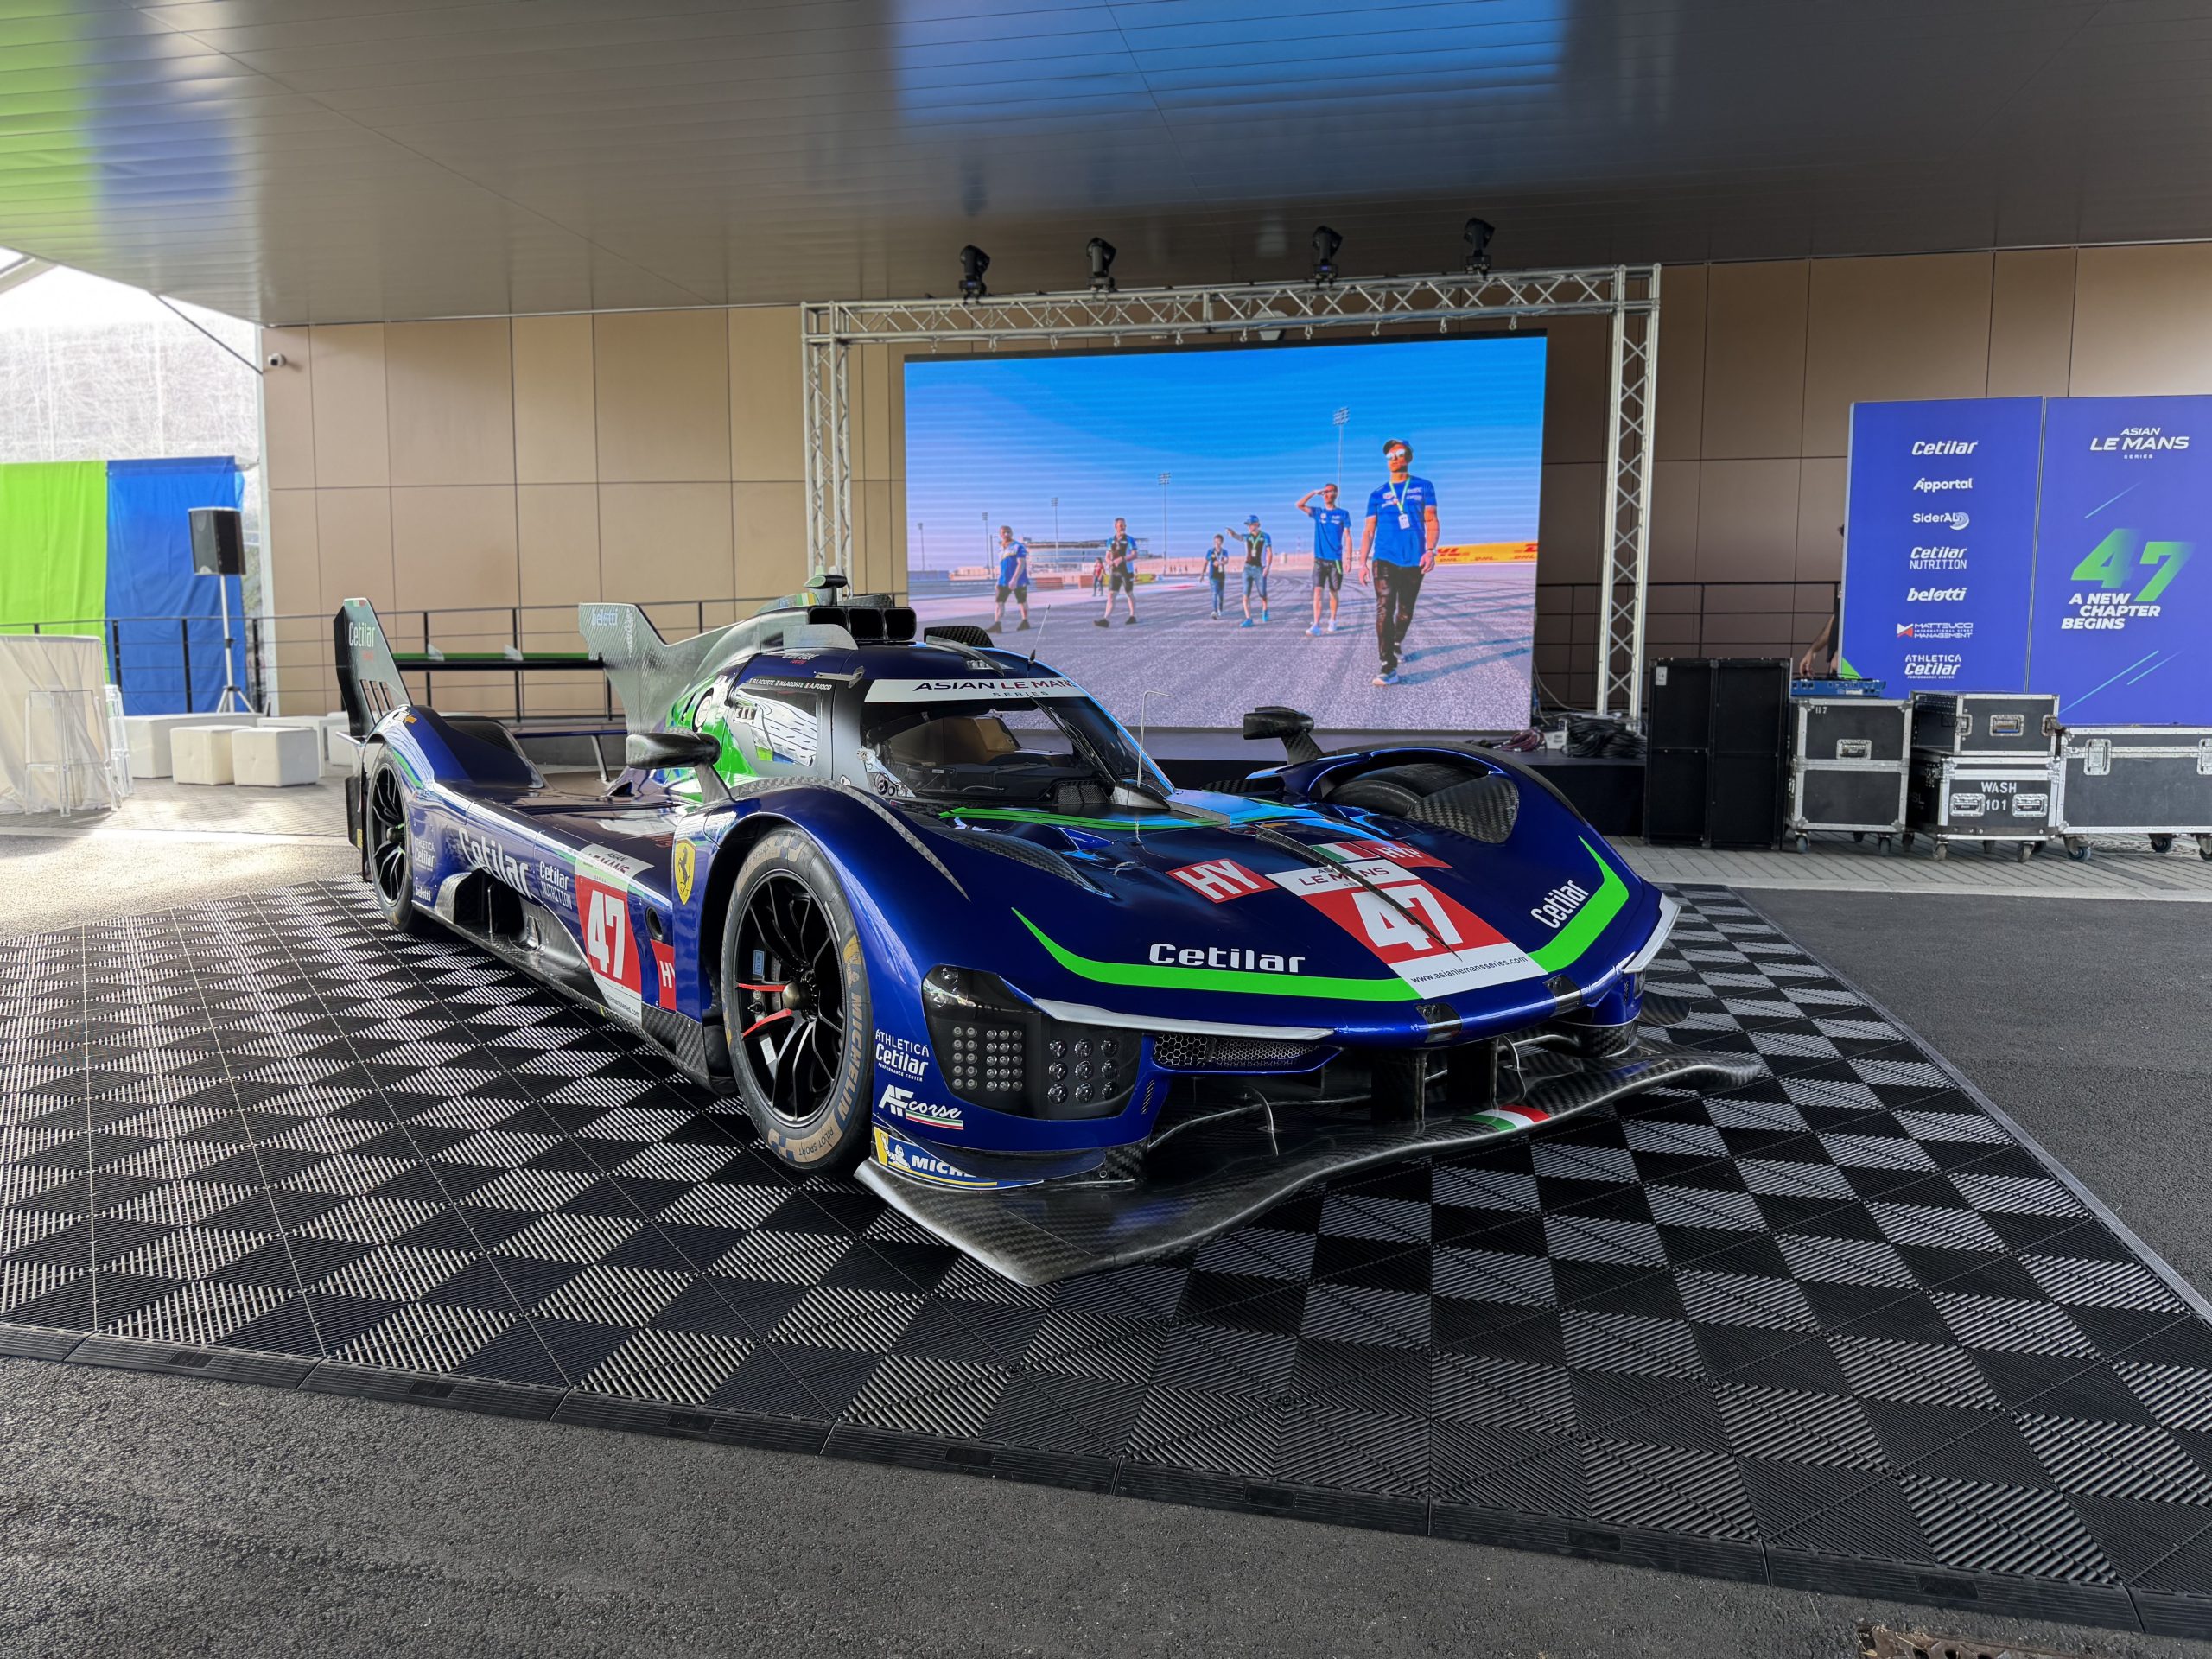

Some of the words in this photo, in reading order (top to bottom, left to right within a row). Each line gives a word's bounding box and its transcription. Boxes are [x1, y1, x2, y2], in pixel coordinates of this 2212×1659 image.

[1911, 441, 1978, 455] Cetilar
[2090, 438, 2120, 451] LE
[2122, 436, 2190, 450] MANS
[1910, 546, 1967, 559] Cetilar
[1910, 560, 1967, 569] NUTRITION
[2070, 529, 2197, 602] 47
[1907, 588, 1967, 601] belotti
[2069, 593, 2083, 605] A
[2087, 593, 2131, 605] NEW
[2080, 606, 2161, 617] CHAPTER
[2061, 618, 2126, 630] BEGINS
[349, 622, 375, 647] Cetilar
[1905, 654, 1961, 663] ATHLETICA
[1904, 663, 1961, 676] Cetilar
[912, 682, 995, 691] ASIAN
[1980, 782, 2017, 794] WASH
[1986, 800, 2007, 810] 101
[415, 848, 435, 868] Cetilar
[1375, 846, 1423, 859] HYP
[459, 827, 533, 900] Cetilar
[539, 861, 569, 891] Cetilar
[1299, 875, 1329, 886] LE
[1328, 868, 1390, 882] MNS
[541, 880, 573, 910] NUTRITION
[1531, 880, 1590, 929] Cetilar
[1351, 884, 1464, 951] 47
[588, 889, 626, 979] 47
[1149, 943, 1306, 973] Cetilar
[1411, 955, 1528, 984] www.asianlemansseries.com
[875, 1029, 930, 1058] ATHLETICA
[838, 993, 862, 1121] MICHELIN
[875, 1044, 929, 1076] Cetilar
[878, 1062, 904, 1077] PERFORMANCE
[906, 1073, 923, 1082] CENTER
[878, 1084, 914, 1117] AF
[818, 1126, 834, 1147] PILOT
[798, 1143, 817, 1156] SPORT
